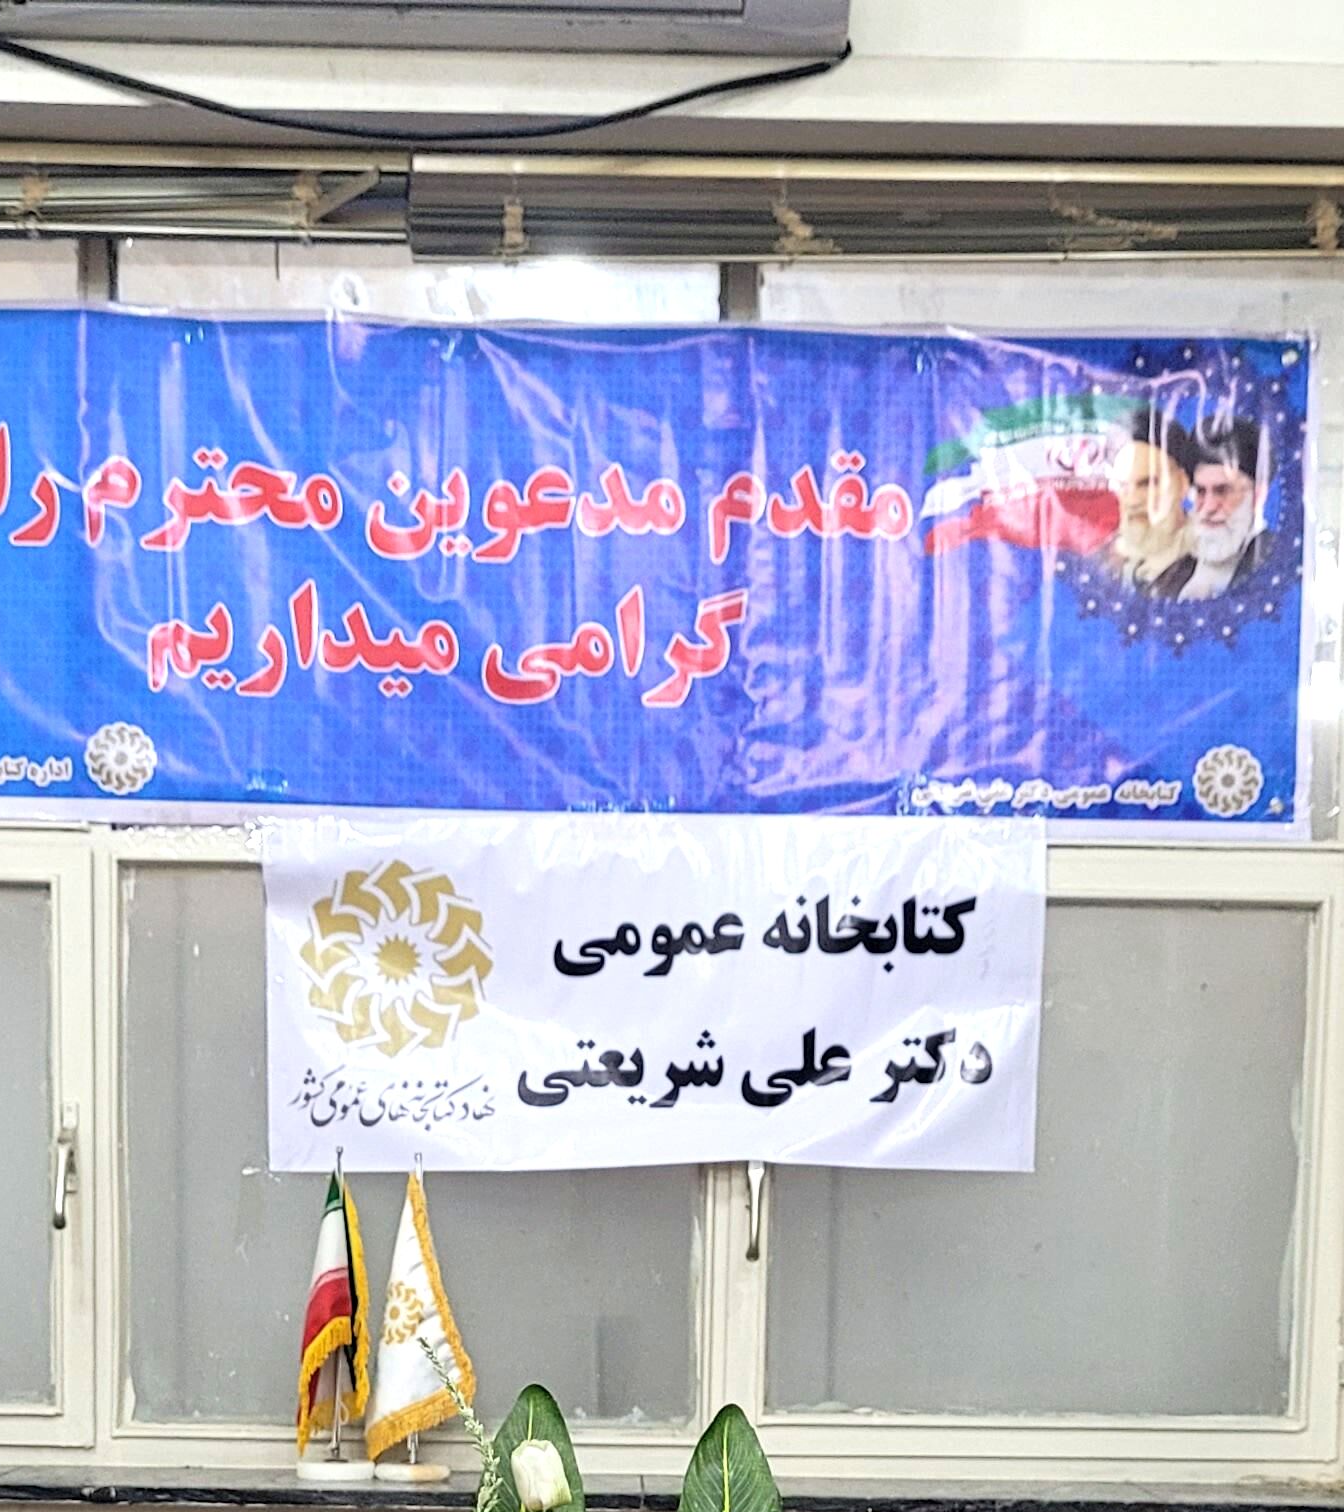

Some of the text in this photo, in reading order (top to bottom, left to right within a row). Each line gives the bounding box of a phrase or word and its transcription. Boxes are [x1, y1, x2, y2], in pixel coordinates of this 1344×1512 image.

[84, 446, 343, 550] محترم
[366, 463, 685, 562] مدعوین
[711, 451, 913, 565] مقدم
[148, 579, 747, 707] گرامی میداریم
[28, 756, 72, 787] اداره
[1054, 784, 1112, 810] عمومی
[1114, 780, 1182, 810] کتابخانه
[553, 895, 976, 977] کتابخانه عمومی
[517, 1028, 993, 1110] دکتر علی شریعتی
